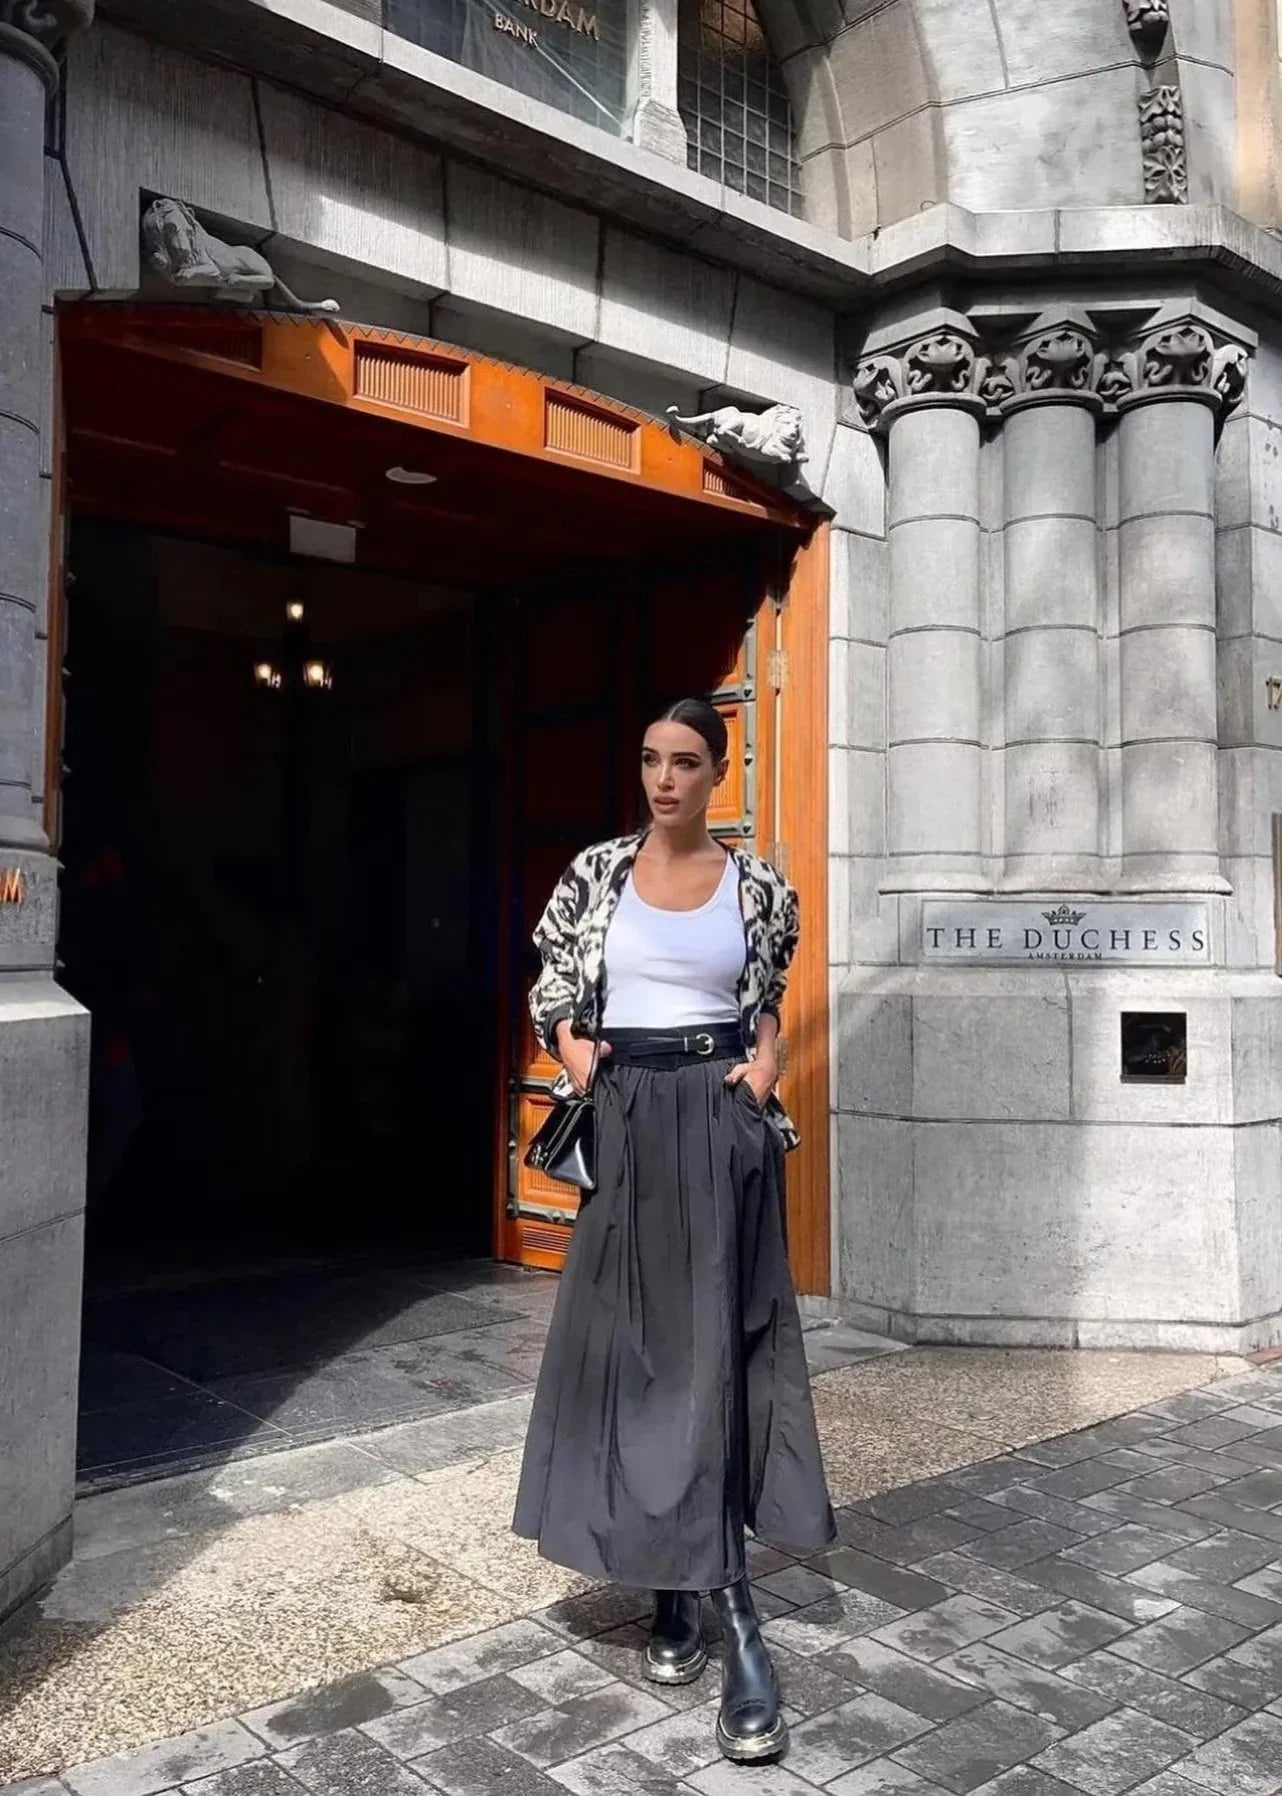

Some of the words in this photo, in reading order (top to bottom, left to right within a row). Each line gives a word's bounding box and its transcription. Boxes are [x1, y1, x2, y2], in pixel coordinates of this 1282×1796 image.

[495, 13, 538, 46] BANK
[926, 927, 1003, 949] THE
[1023, 928, 1204, 951] DUCHESS
[1027, 952, 1103, 960] AMSTERDAM
